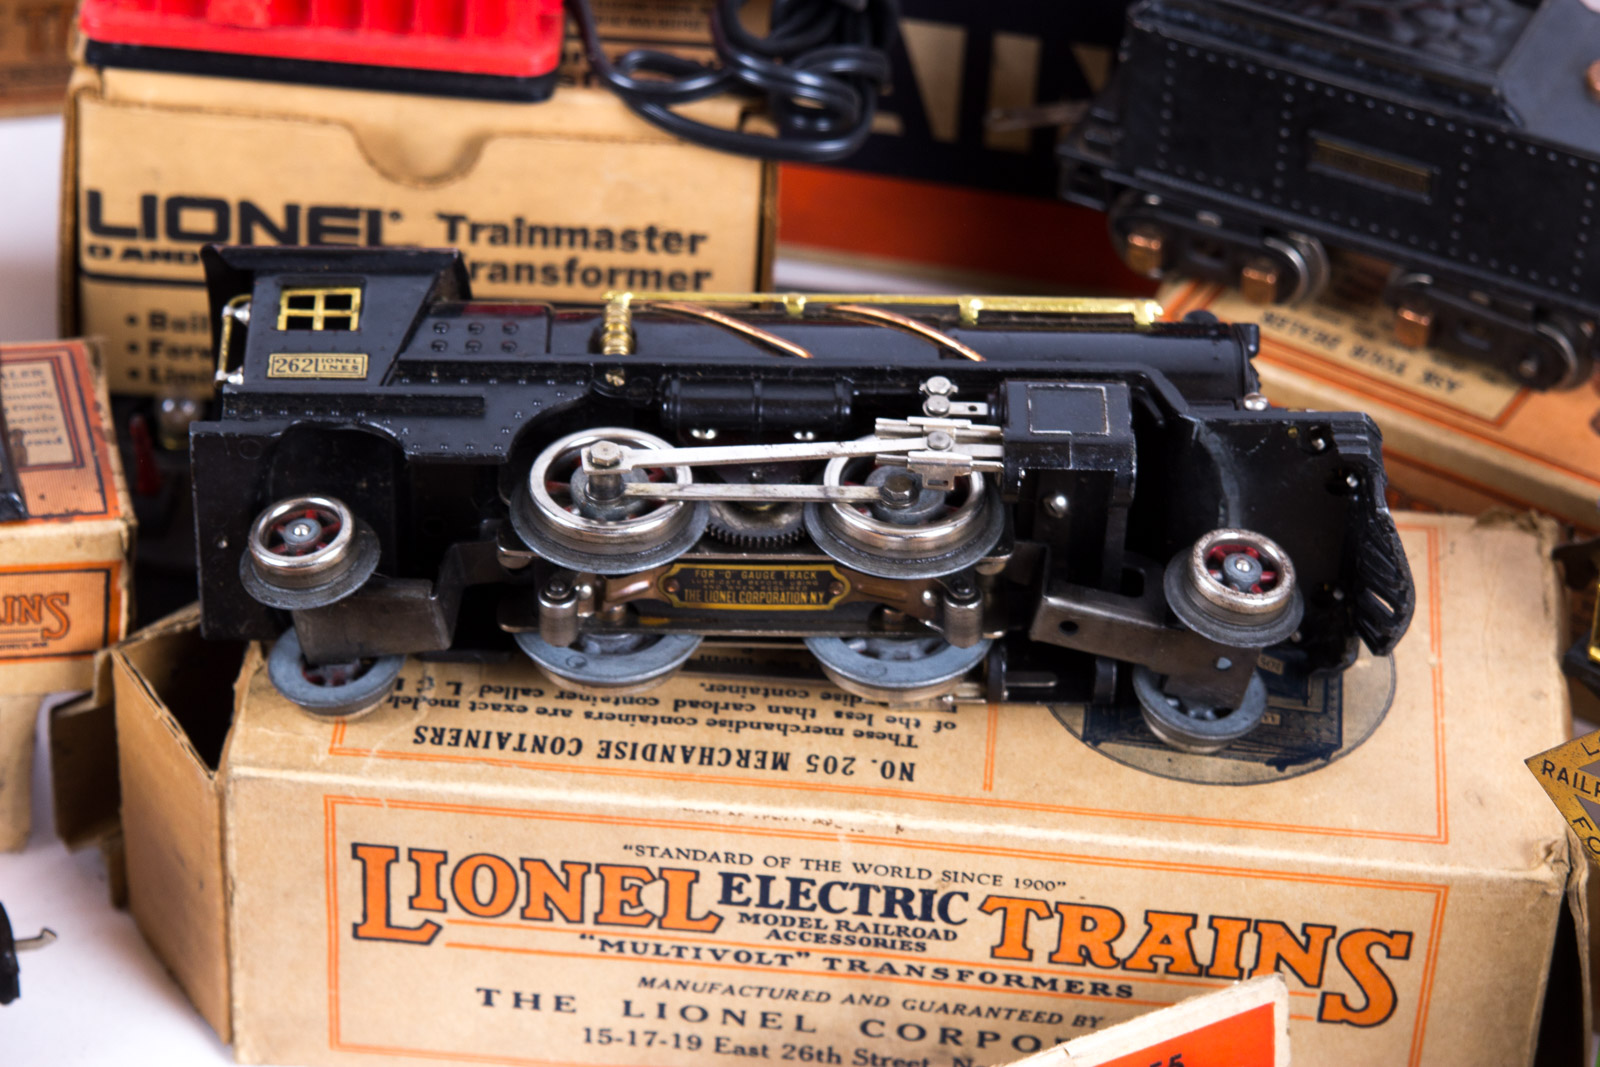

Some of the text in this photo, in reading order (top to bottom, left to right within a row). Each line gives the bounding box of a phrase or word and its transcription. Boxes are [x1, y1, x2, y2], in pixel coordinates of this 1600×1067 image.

[437, 211, 708, 254] Trainmaster
[468, 257, 712, 292] ransformer
[695, 569, 715, 578] FOR
[741, 570, 776, 580] GAUGE
[783, 570, 817, 580] TRACK
[684, 588, 701, 602] THE
[704, 589, 736, 603] LIONEL
[738, 590, 808, 604] CORPORATION
[479, 683, 545, 700] called
[555, 690, 660, 706] container
[700, 682, 810, 700] container.
[469, 700, 528, 713] exact
[536, 706, 573, 717] are
[673, 698, 756, 715] carload
[767, 704, 817, 720] than
[584, 710, 698, 727] containers
[706, 717, 844, 738] merchandise
[834, 710, 874, 726] less
[885, 714, 922, 729] the
[933, 720, 957, 733] of
[853, 727, 919, 749] These
[413, 725, 916, 782] NO. 205 MERCHANDISE CONTAINERS
[763, 855, 791, 869] OF
[800, 858, 842, 873] THE
[852, 862, 932, 880] WORLD
[941, 870, 1004, 887] SINCE
[351, 842, 1413, 1028] LIONEL ELECTRIC TRAINS
[738, 912, 958, 942] MODEL RAILROAD
[765, 929, 927, 953] ACCESSORIES
[822, 957, 1133, 998] TRANSFORMERS
[476, 987, 577, 1014] THE
[622, 1000, 816, 1033] LIONEL
[637, 977, 1104, 1029] MANUFACTURED AND GUARANTEED BY
[584, 1027, 703, 1051] 15-17-19
[714, 1036, 770, 1059] East
[781, 1043, 842, 1065] 26th
